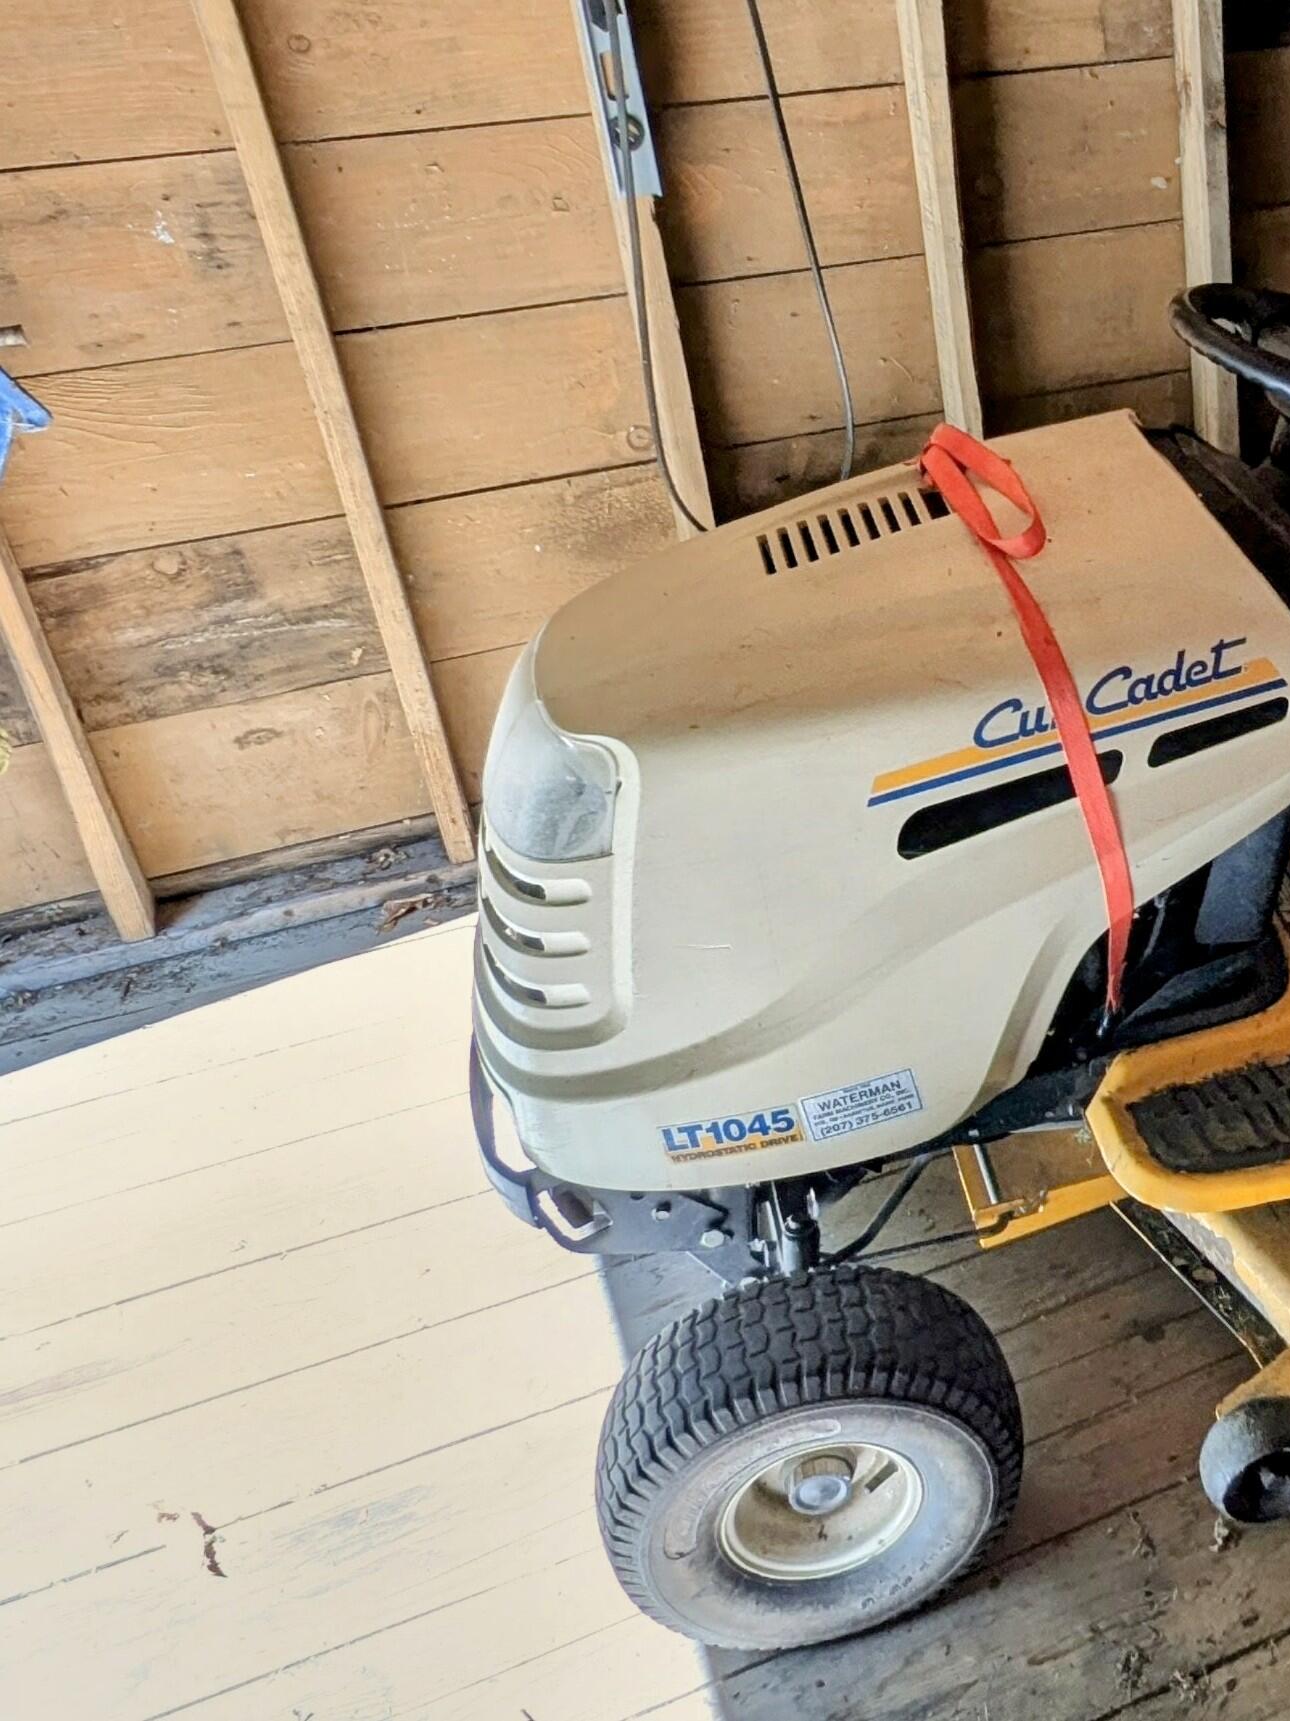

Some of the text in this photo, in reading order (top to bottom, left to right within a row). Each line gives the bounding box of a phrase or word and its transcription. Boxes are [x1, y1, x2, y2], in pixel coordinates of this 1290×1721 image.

[973, 637, 1247, 749] Cu Cadet
[817, 1080, 901, 1111] WATERMAN
[662, 1108, 795, 1152] LT1045
[820, 1120, 853, 1137] (207)
[855, 1101, 912, 1126] 375-6561
[671, 1133, 799, 1163] HYDROSTATIC DRIVE
